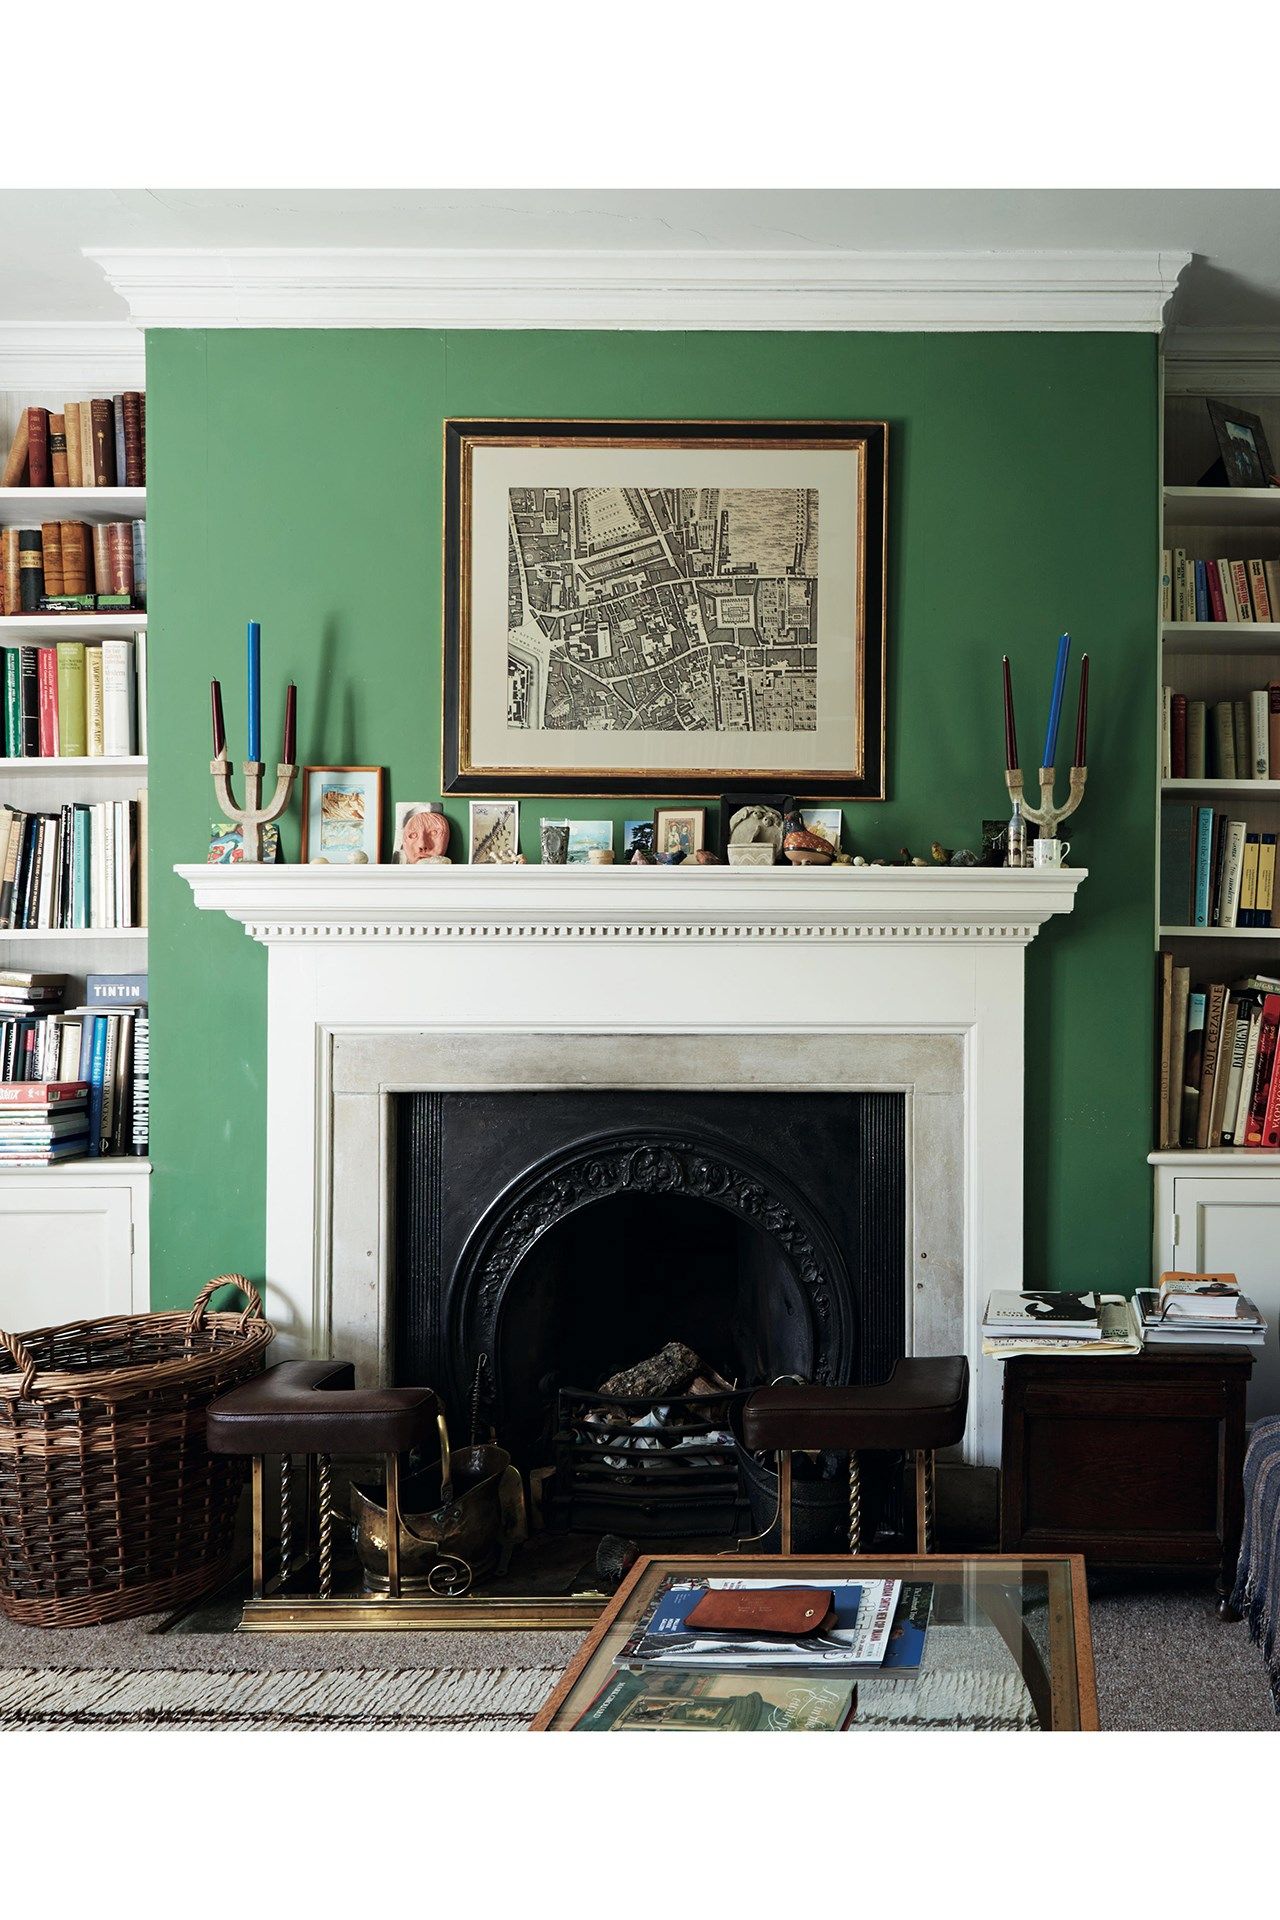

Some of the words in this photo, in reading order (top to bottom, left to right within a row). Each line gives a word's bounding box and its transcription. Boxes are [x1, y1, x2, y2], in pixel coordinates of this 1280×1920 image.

[1236, 563, 1249, 604] WELLINGTON
[1257, 576, 1268, 616] WELLINGTON
[94, 986, 140, 996] TINTIN
[1206, 986, 1223, 1043] CEZANNE
[1226, 1010, 1235, 1029] VAN
[134, 1018, 149, 1074] KAZIMIR
[1233, 1020, 1248, 1068] DAUBIGNY
[1204, 1047, 1216, 1076] PAUL
[102, 1086, 111, 1129] FRANCESCA
[132, 1079, 148, 1144] MALEVICH
[1272, 1103, 1280, 1128] GOYA
[658, 1618, 668, 1631] GALLERY
[665, 1618, 673, 1629] HOUSE
[875, 1612, 888, 1620] NEW
[870, 1629, 884, 1642] DRAMA
[608, 1681, 626, 1696] MARK
[593, 1695, 613, 1719] GIROUARD
